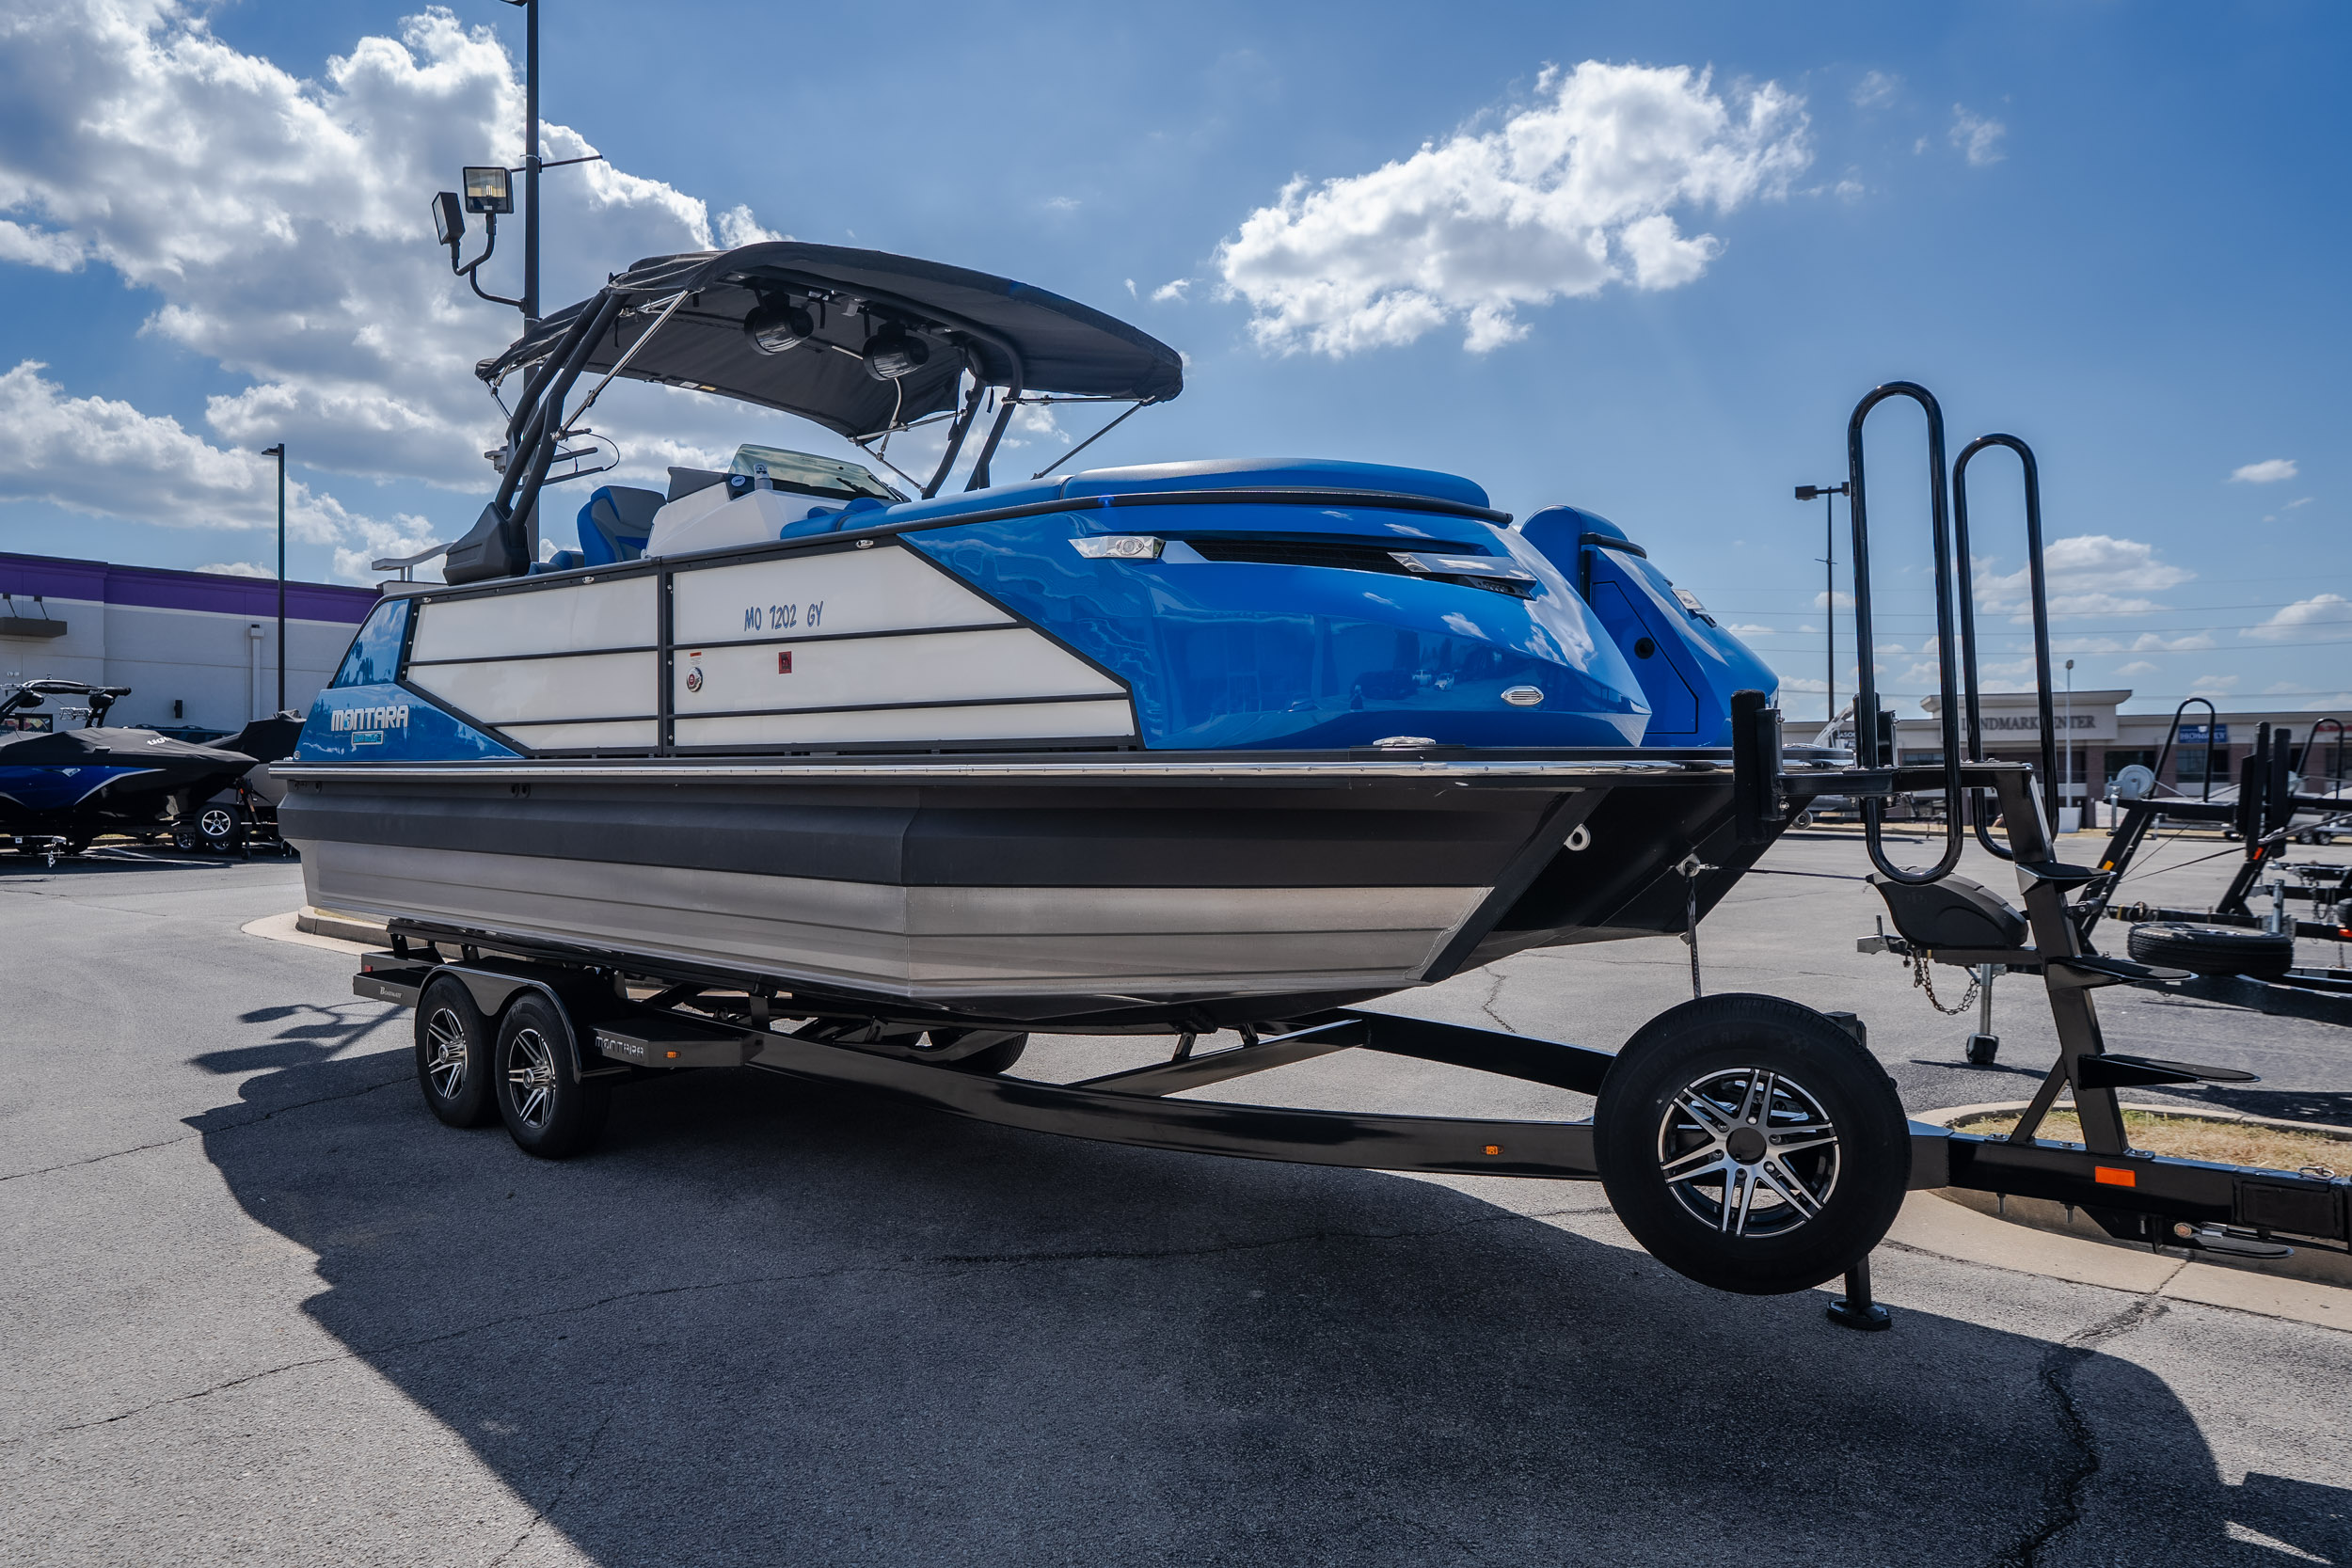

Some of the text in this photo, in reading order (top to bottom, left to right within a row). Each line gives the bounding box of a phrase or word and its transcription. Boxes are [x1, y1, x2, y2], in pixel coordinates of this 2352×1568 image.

[744, 601, 823, 631] MO 1202 GY
[331, 705, 409, 732] MONTARA
[1962, 715, 2096, 731] LNDMARK ENTER
[595, 1036, 644, 1058] MONTARA
